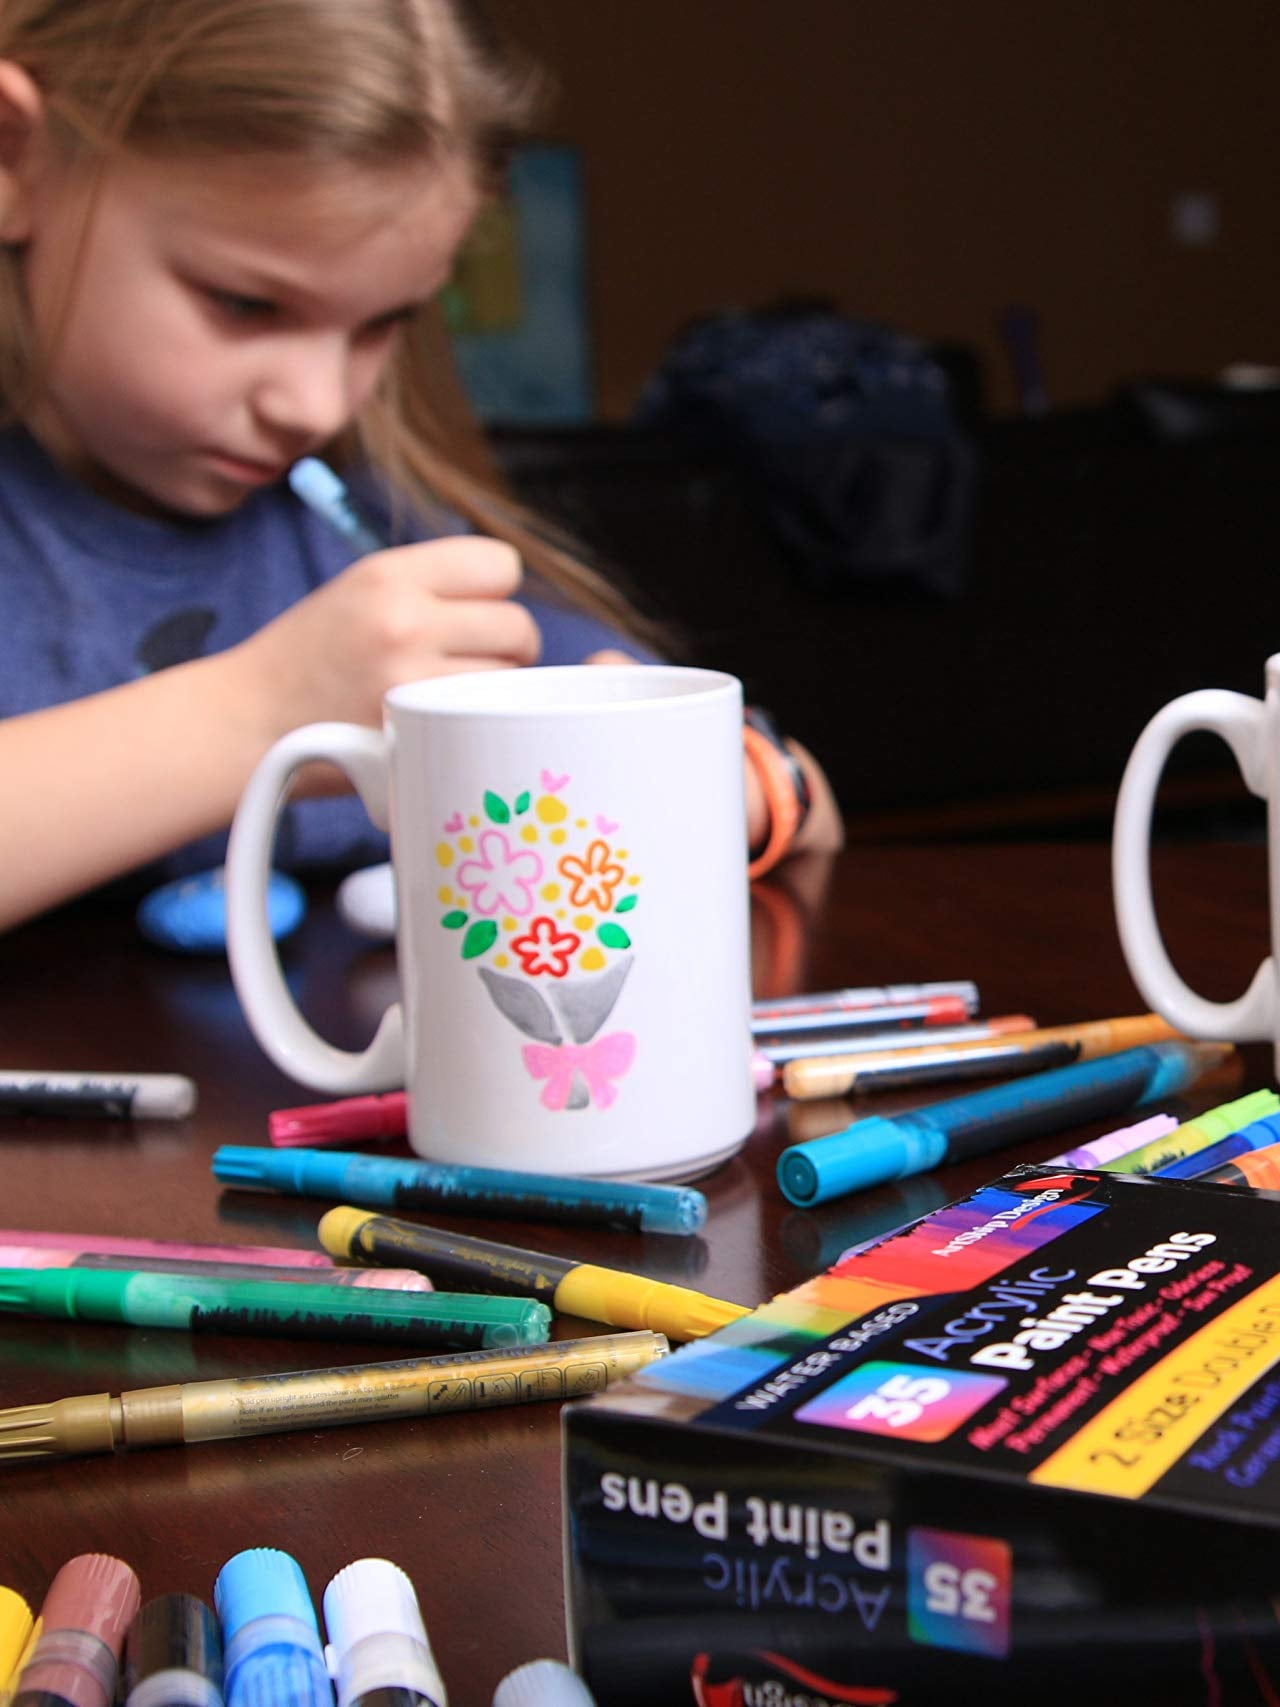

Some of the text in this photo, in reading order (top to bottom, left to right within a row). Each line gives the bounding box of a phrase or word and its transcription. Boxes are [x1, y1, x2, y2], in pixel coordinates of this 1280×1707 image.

[932, 1188, 1064, 1256] ArtShip Design
[904, 1268, 1076, 1361] Acrylic
[972, 1233, 1216, 1369] Paint Pens
[740, 1303, 918, 1408] WATER BASED
[846, 1375, 952, 1427] 35
[601, 1472, 891, 1571] Paint Pens
[703, 1553, 892, 1631] Acrylic
[924, 1561, 998, 1623] 35
